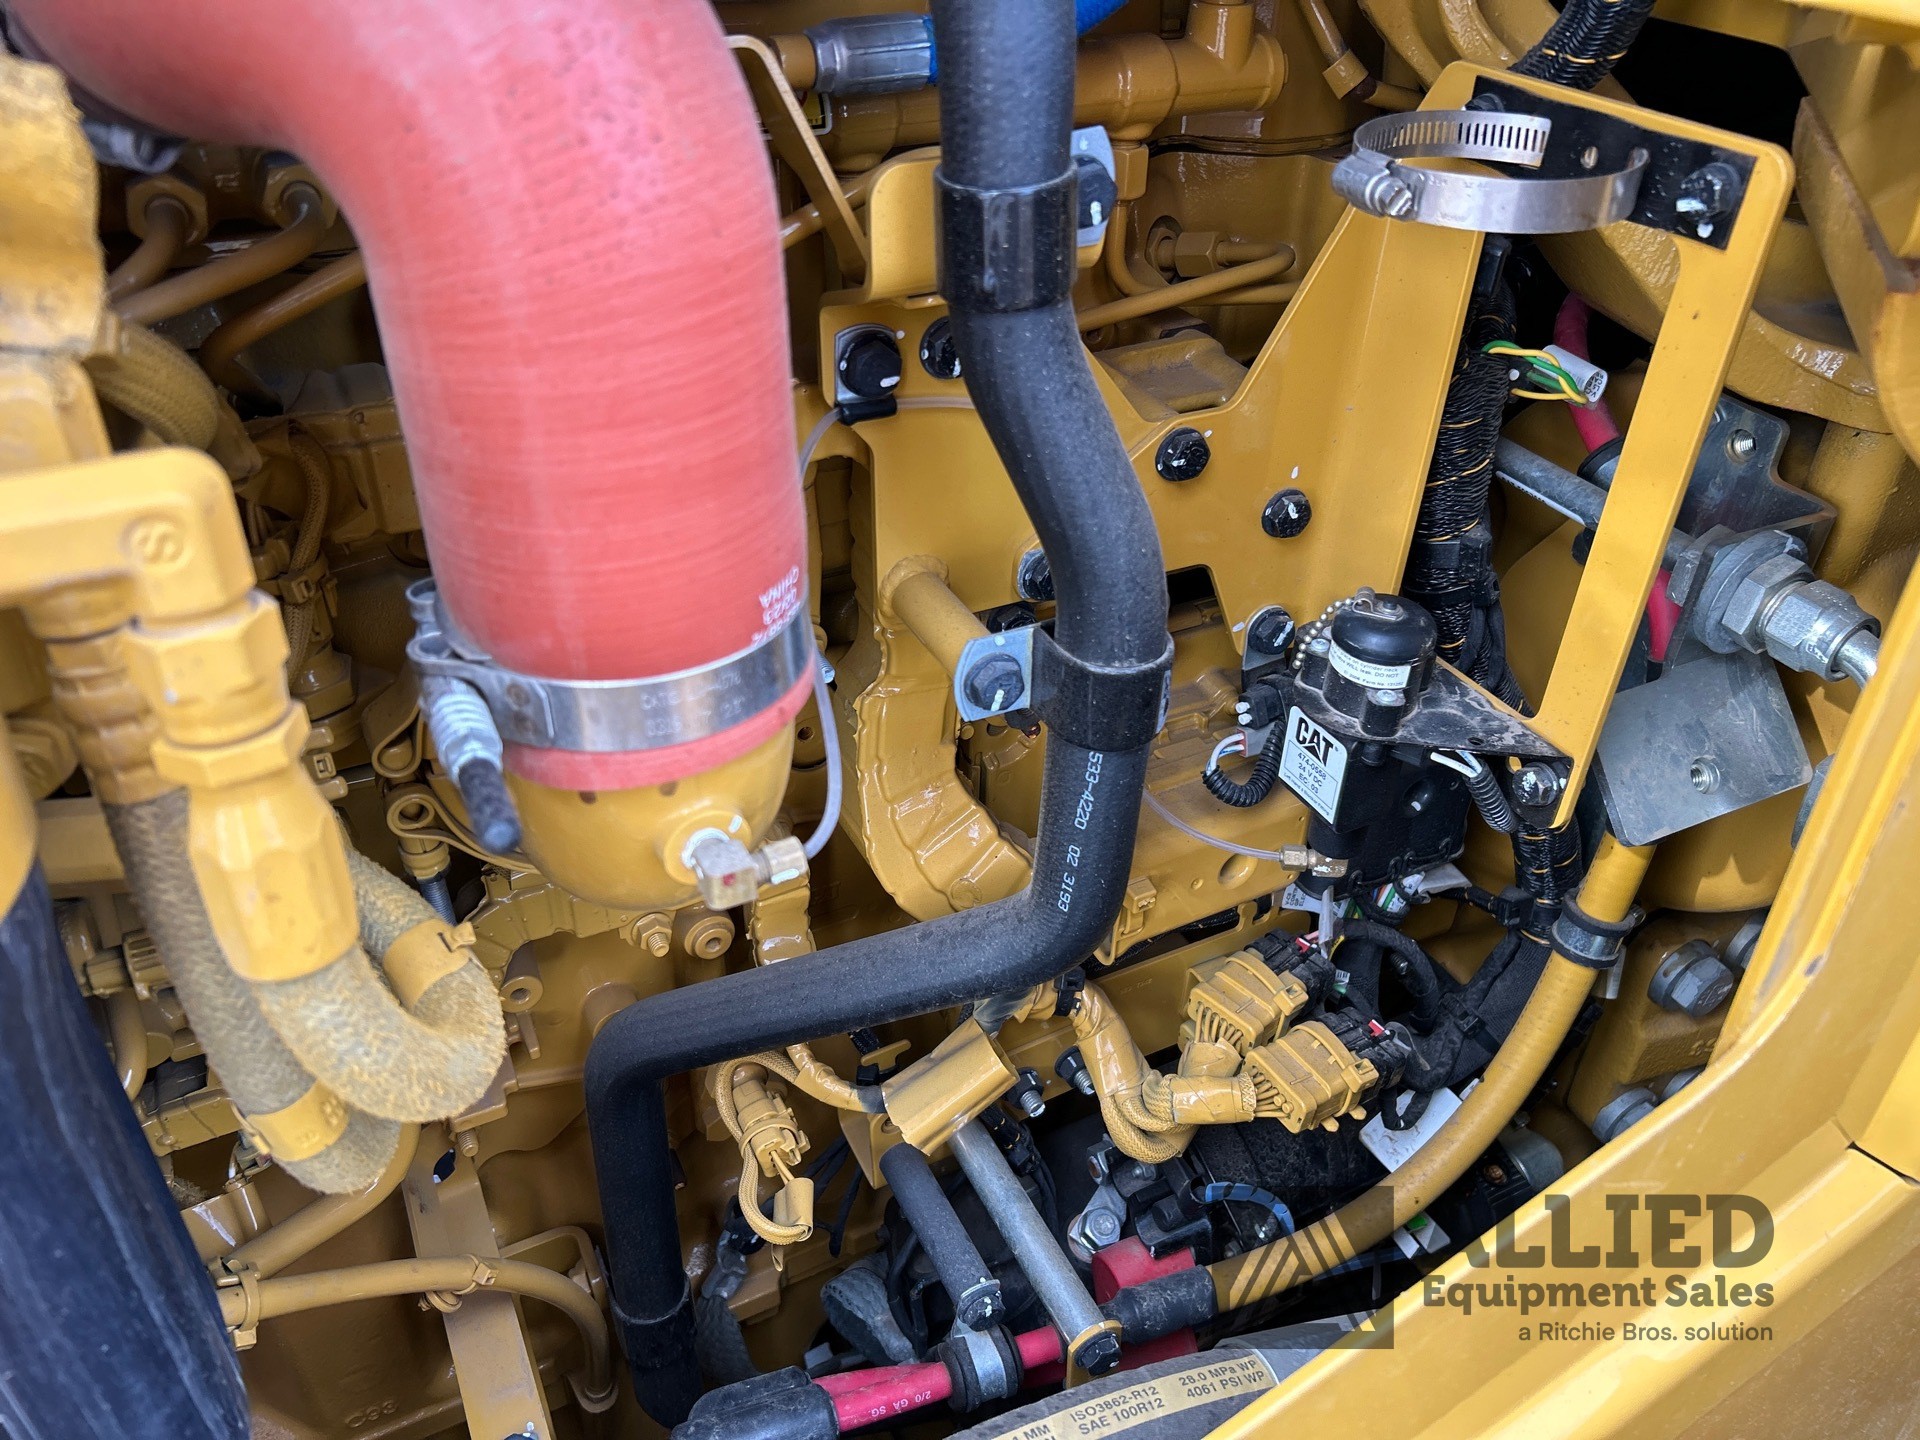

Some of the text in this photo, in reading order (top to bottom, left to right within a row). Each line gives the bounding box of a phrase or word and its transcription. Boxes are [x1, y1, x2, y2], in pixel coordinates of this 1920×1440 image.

[759, 565, 799, 608] CHINA
[1296, 717, 1334, 767] CAT
[1298, 762, 1306, 773] 24
[1313, 774, 1322, 787] DC
[1058, 751, 1103, 912] 533-4220 02 3193
[893, 1399, 909, 1410] GA
[915, 1390, 931, 1403] 2/0
[1069, 1386, 1159, 1422] ISO3862-R12
[1178, 1371, 1207, 1386] 28.0
[1209, 1365, 1237, 1380] MPa
[1236, 1359, 1257, 1374] WP
[1079, 1370, 1266, 1435] SAE 100R12 4061 PSI WP
